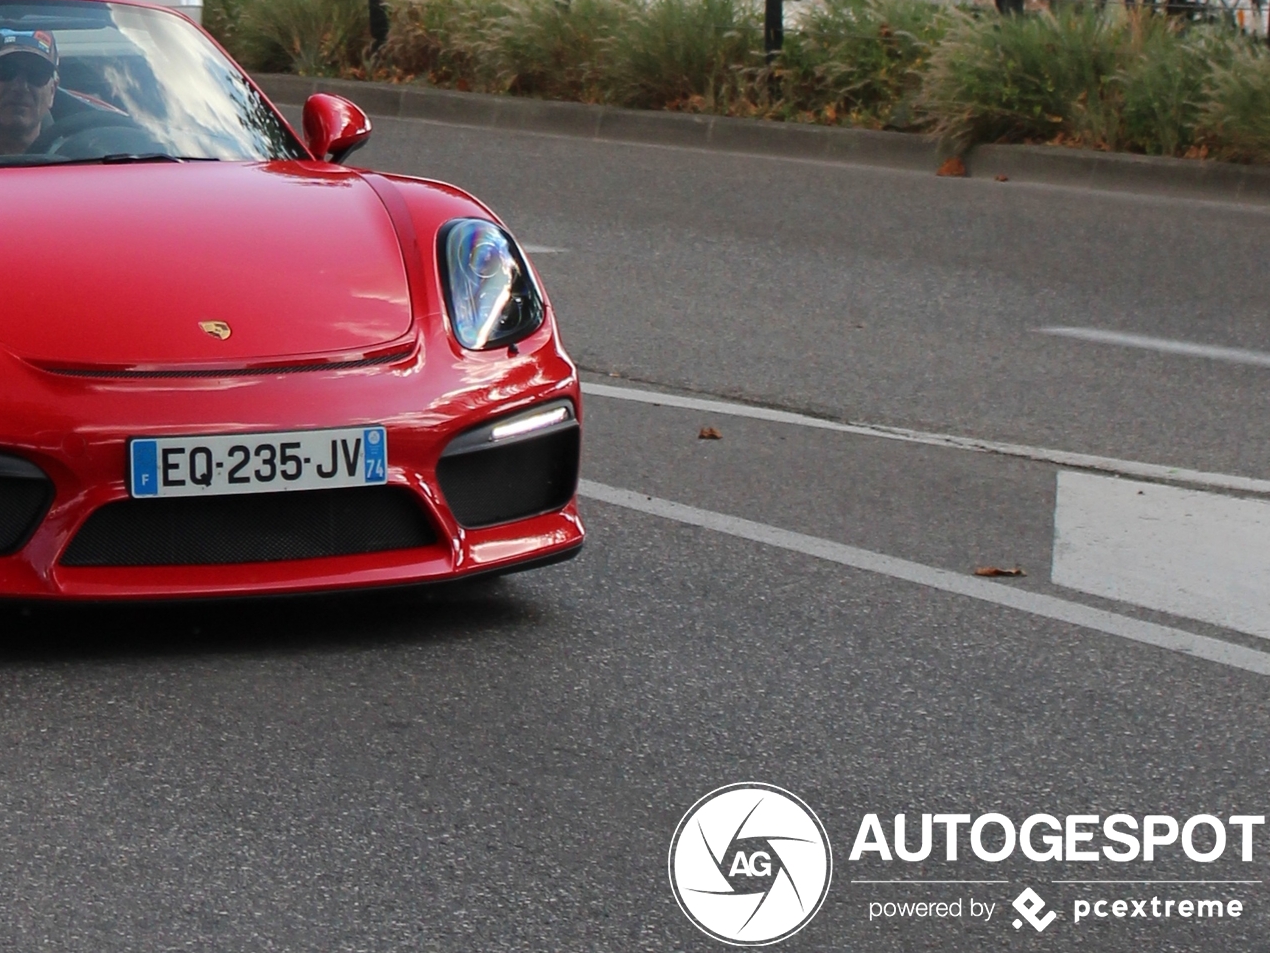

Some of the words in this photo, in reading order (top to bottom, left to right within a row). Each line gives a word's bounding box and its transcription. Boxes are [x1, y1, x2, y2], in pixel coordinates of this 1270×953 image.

[141, 474, 150, 486] F
[161, 438, 362, 487] EQ-235-JV
[366, 458, 384, 479] 74
